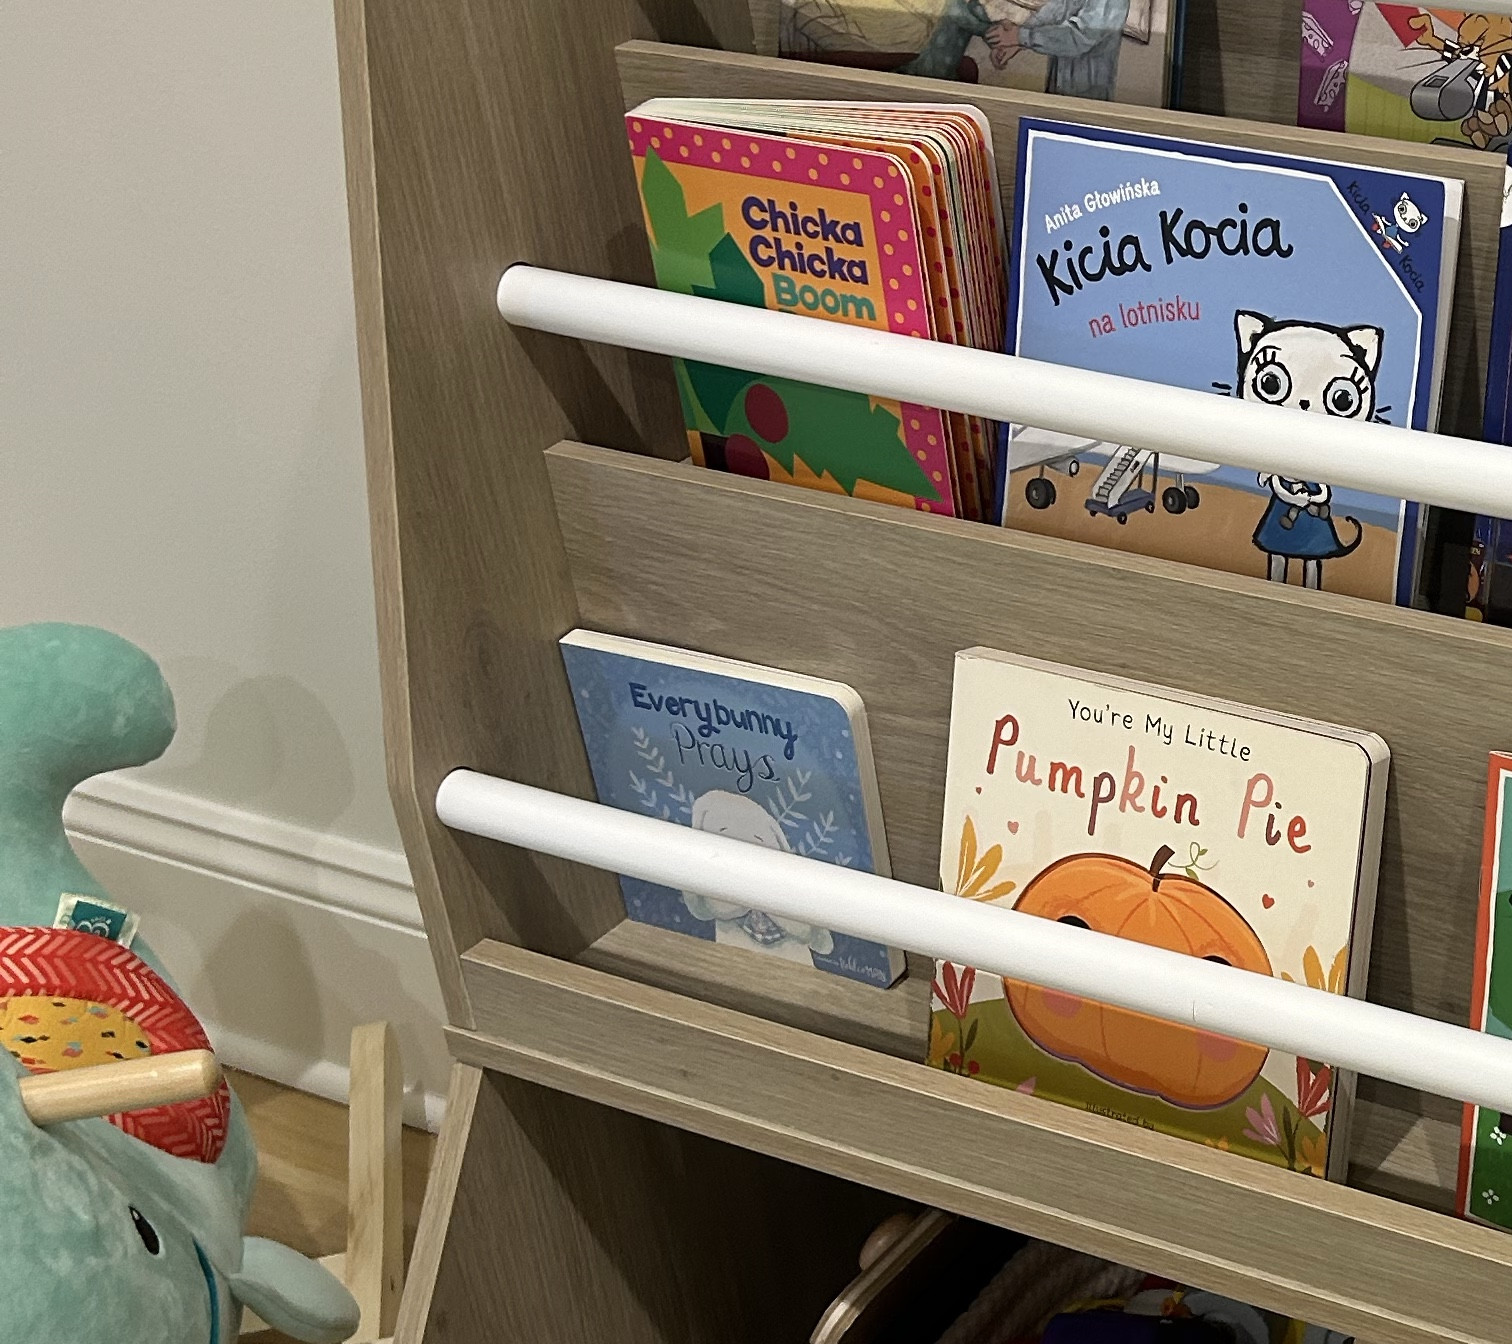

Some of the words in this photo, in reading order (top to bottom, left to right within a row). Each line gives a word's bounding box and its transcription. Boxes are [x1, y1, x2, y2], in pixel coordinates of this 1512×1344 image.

[741, 195, 865, 248] Chicka
[1044, 205, 1083, 235] Anita
[1083, 177, 1161, 214] Głowińska
[748, 235, 869, 286] Chicka
[1035, 224, 1152, 307] Kicia
[1158, 202, 1294, 265] Kocia
[772, 272, 877, 322] Boom
[1088, 314, 1116, 339] na
[1119, 294, 1201, 330] lotnisku
[628, 681, 798, 761] Everybunny
[1067, 697, 1134, 731] You're
[1144, 713, 1174, 746] My
[1185, 724, 1251, 763] Little
[669, 722, 781, 793] Prays
[985, 713, 1200, 836] Pumpkin
[1236, 772, 1312, 854] Pie
